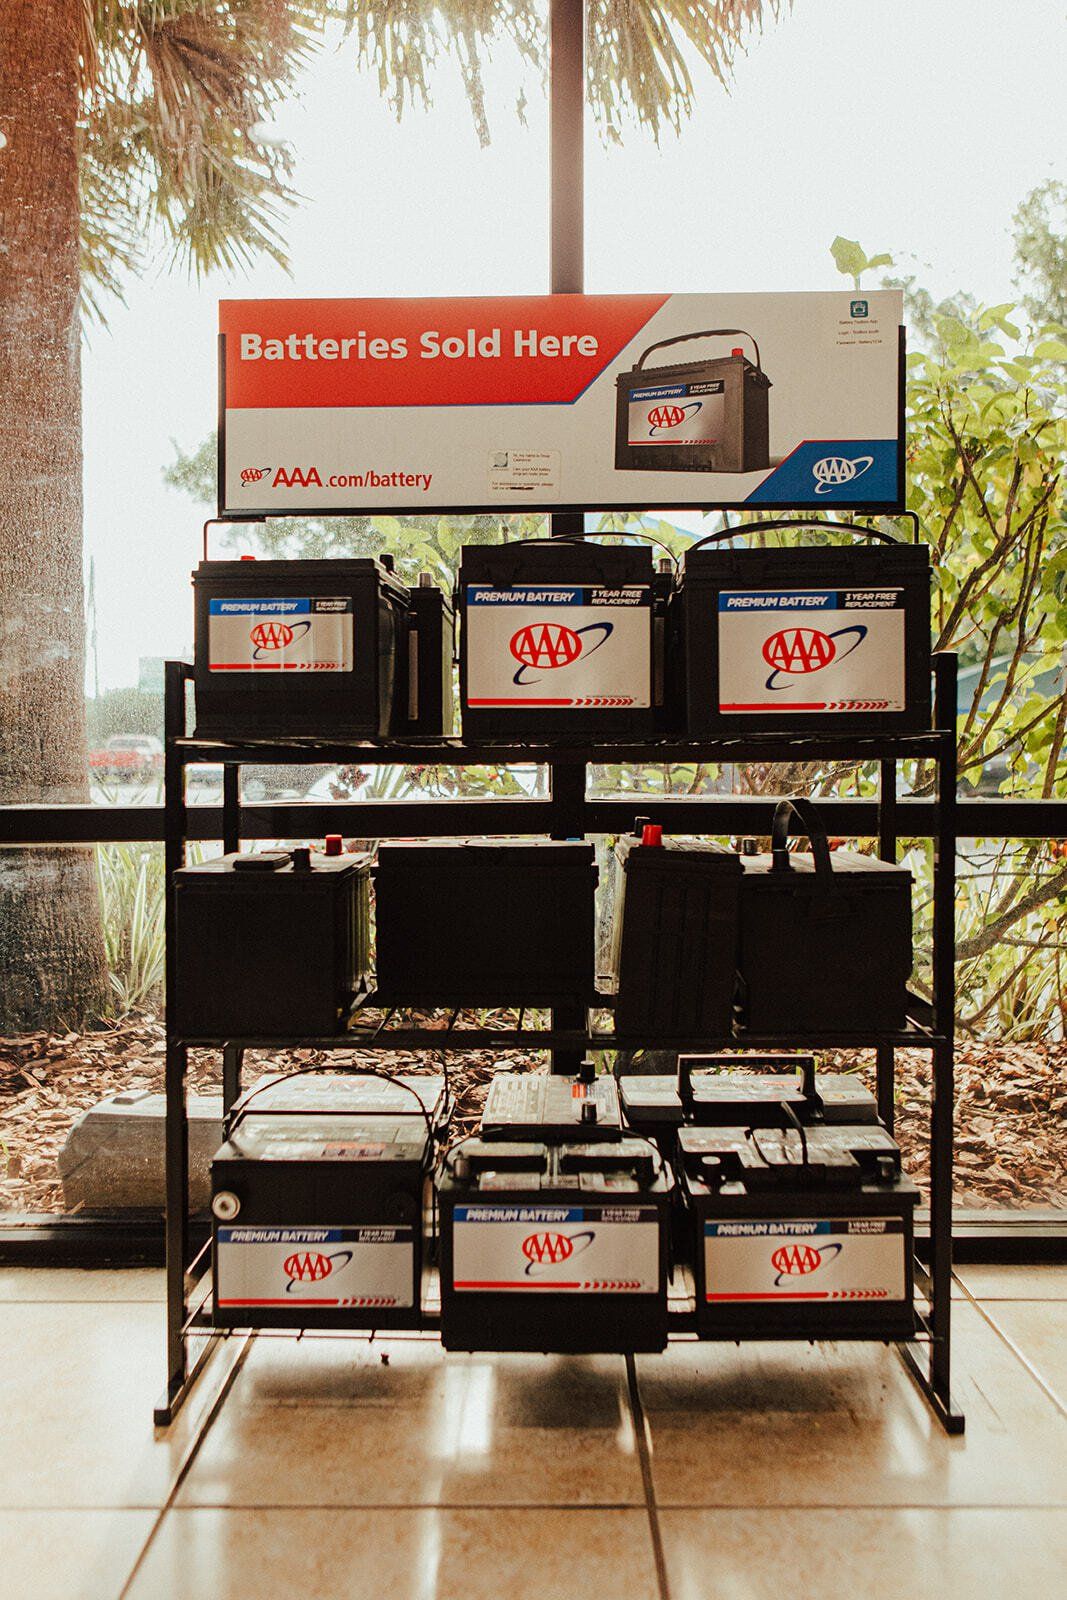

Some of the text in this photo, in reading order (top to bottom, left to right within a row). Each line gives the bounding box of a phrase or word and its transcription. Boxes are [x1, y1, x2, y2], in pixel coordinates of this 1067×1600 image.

[240, 329, 599, 361] Batteries Sold Here
[632, 391, 657, 399] PREMIUM
[650, 405, 683, 428] AAA
[818, 457, 852, 484] AAA
[221, 602, 298, 612] PREMIUM BATTERY
[475, 591, 576, 602] PREMIUM BATTERY
[727, 596, 828, 607] PREMIUM BATTERY
[845, 593, 851, 601] 3
[875, 592, 898, 600] FREE
[253, 622, 291, 650] AAA
[515, 624, 577, 669] AAA
[767, 628, 831, 674] AAA
[467, 1210, 570, 1222] PREMIUM BATTERY
[231, 1230, 329, 1242] PREMIUM BATTERY
[717, 1223, 818, 1235] PREMIUM BATTERY
[526, 1232, 570, 1264] AAA
[773, 1244, 819, 1275] AAA
[287, 1251, 329, 1282] AAA
